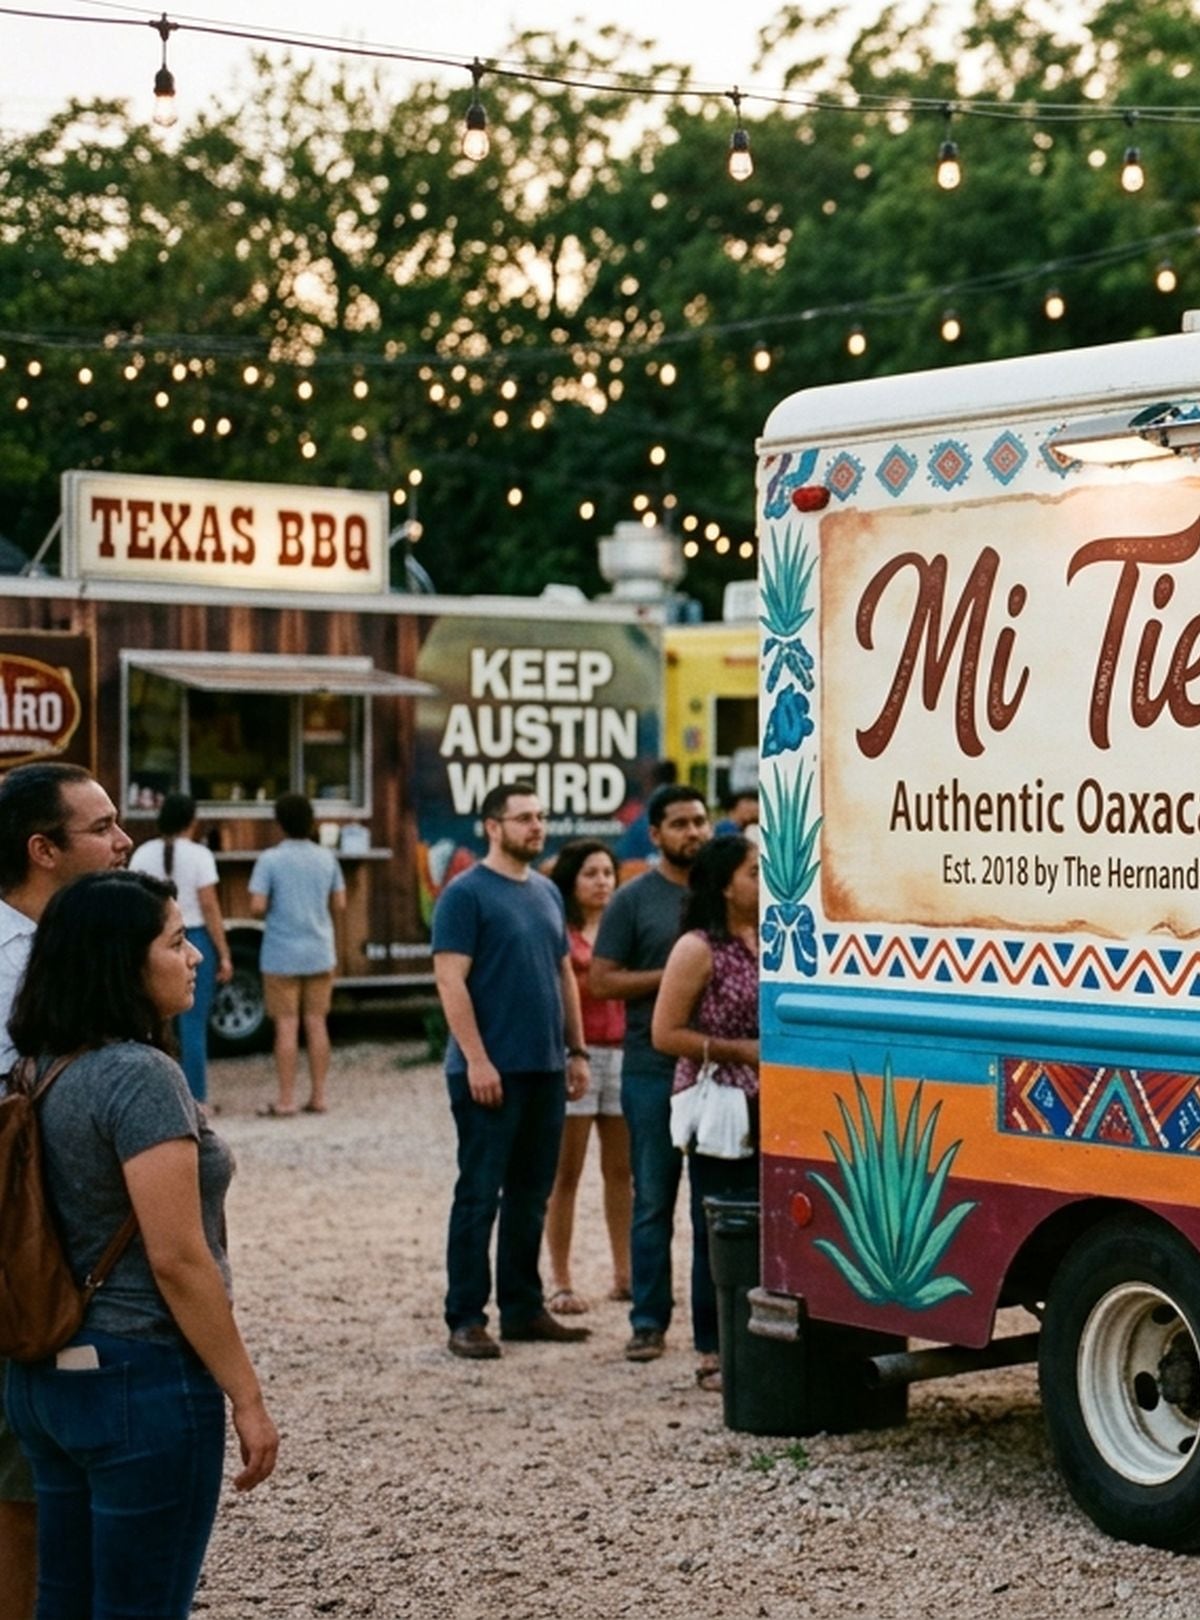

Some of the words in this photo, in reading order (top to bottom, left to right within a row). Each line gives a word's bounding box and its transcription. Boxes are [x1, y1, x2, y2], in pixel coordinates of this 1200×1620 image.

[91, 497, 256, 565] TEXAS
[278, 510, 370, 573] BBQ
[471, 648, 613, 702] KEEP
[855, 546, 1030, 759] Mi
[440, 704, 638, 760] AUSTIN
[890, 778, 1065, 833] Authentic
[943, 855, 977, 886] Est.
[982, 855, 1029, 888] 2018
[1034, 856, 1060, 895] by
[1064, 857, 1102, 890] The
